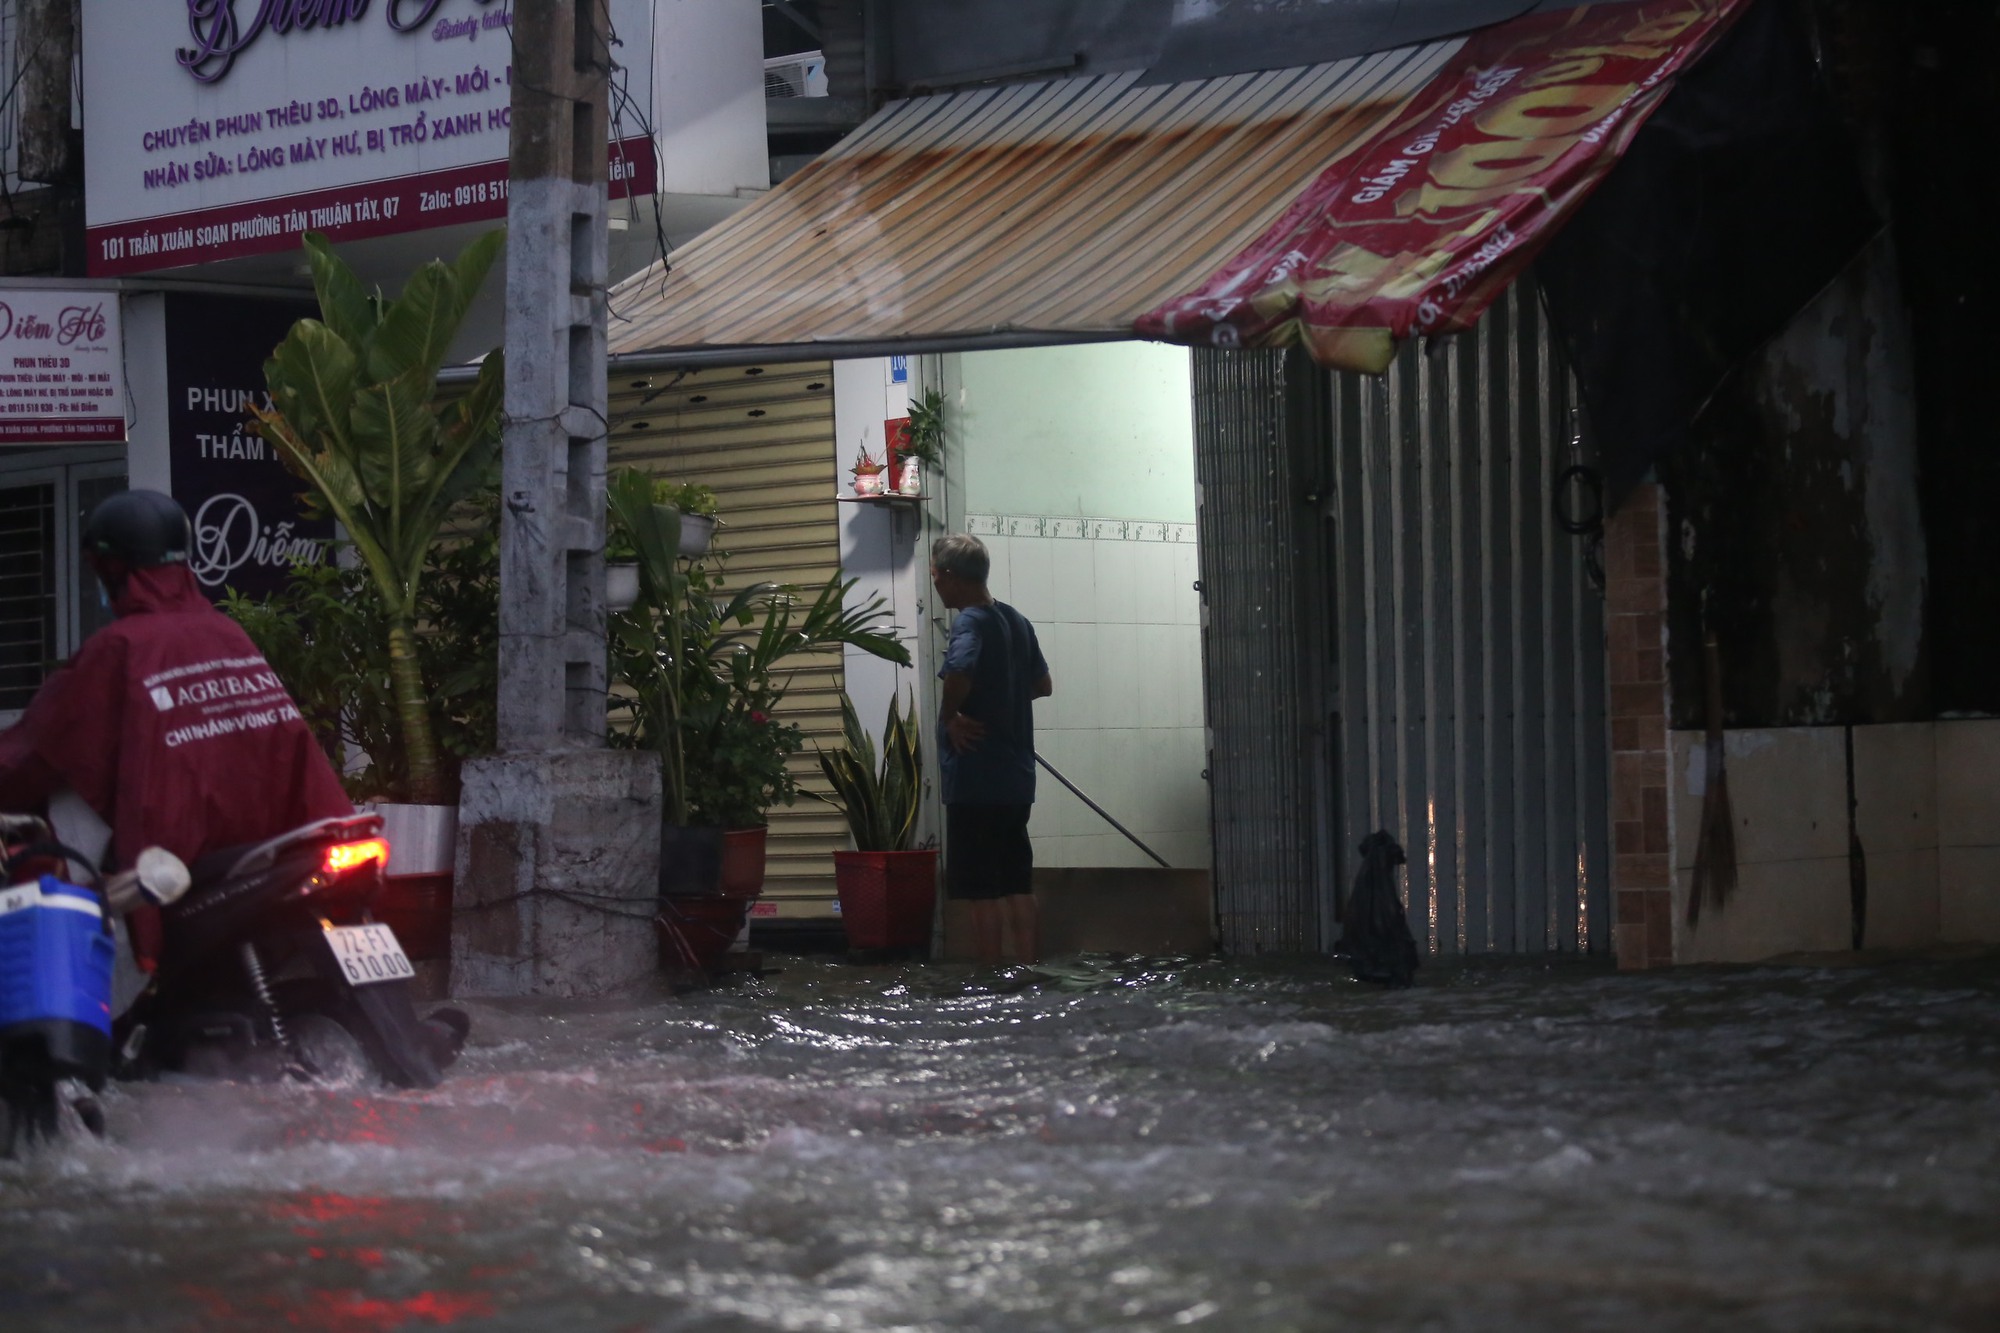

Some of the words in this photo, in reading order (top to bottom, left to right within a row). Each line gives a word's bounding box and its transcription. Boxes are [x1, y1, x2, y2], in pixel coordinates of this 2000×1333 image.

[143, 119, 211, 152] CHUYÊN
[215, 112, 263, 143] PHUN
[266, 100, 312, 134] THÊU
[349, 85, 399, 115] LÔNG
[144, 158, 189, 190] NHẬN
[193, 151, 233, 183] SỬA:
[238, 143, 284, 174] LÔNG
[290, 133, 327, 164] MÀY
[367, 125, 386, 154] BỊ
[391, 110, 428, 145] TRỔ
[432, 107, 483, 141] XANH
[488, 107, 512, 131] HO
[608, 156, 636, 182] iễm
[420, 189, 451, 213] Zalo:
[454, 183, 486, 207] 0918
[101, 237, 125, 262] 101
[129, 226, 159, 257] TRẦN
[161, 224, 194, 252] XUÂN
[196, 225, 229, 251] SOẠN
[232, 213, 281, 242] PHƯỜNG
[284, 207, 308, 233] TÂN
[310, 202, 352, 231] THUẬN
[13, 358, 36, 369] PHUN
[38, 354, 58, 368] THÊU
[60, 358, 71, 368] 3D
[187, 387, 254, 414] PHUN
[196, 422, 264, 461] THẨM
